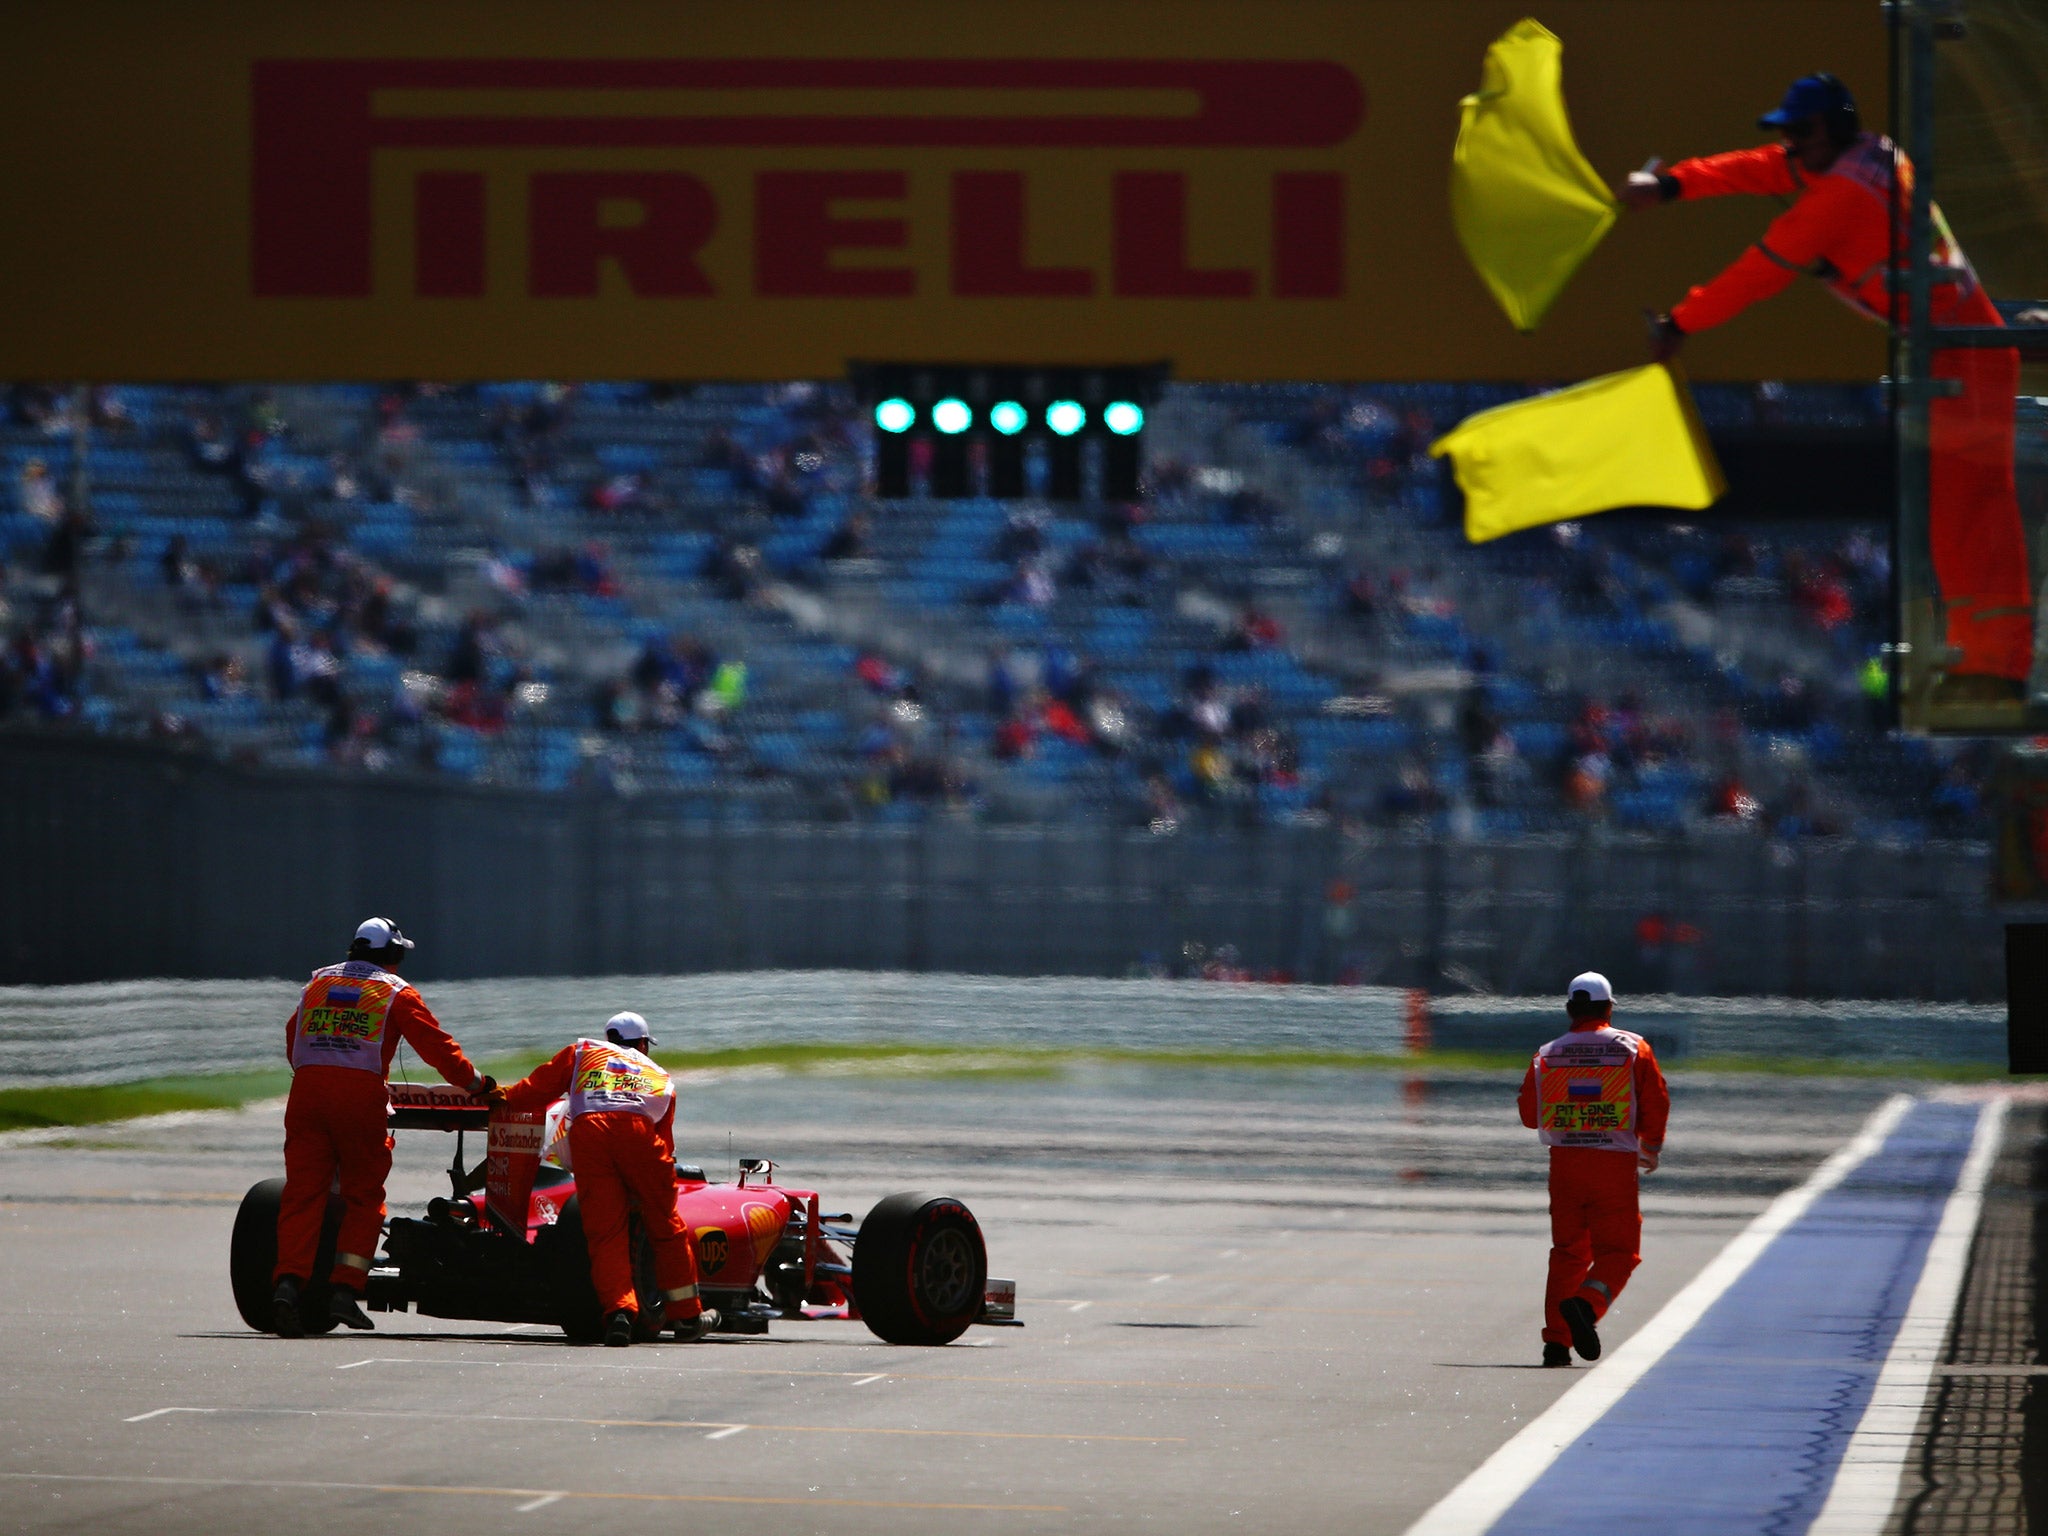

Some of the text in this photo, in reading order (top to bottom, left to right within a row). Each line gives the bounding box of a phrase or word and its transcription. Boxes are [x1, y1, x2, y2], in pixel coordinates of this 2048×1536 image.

[251, 58, 1367, 299] PIRELLI
[311, 1009, 330, 1021] PIT
[1555, 1104, 1576, 1115] PIT
[499, 1129, 542, 1149] Santander
